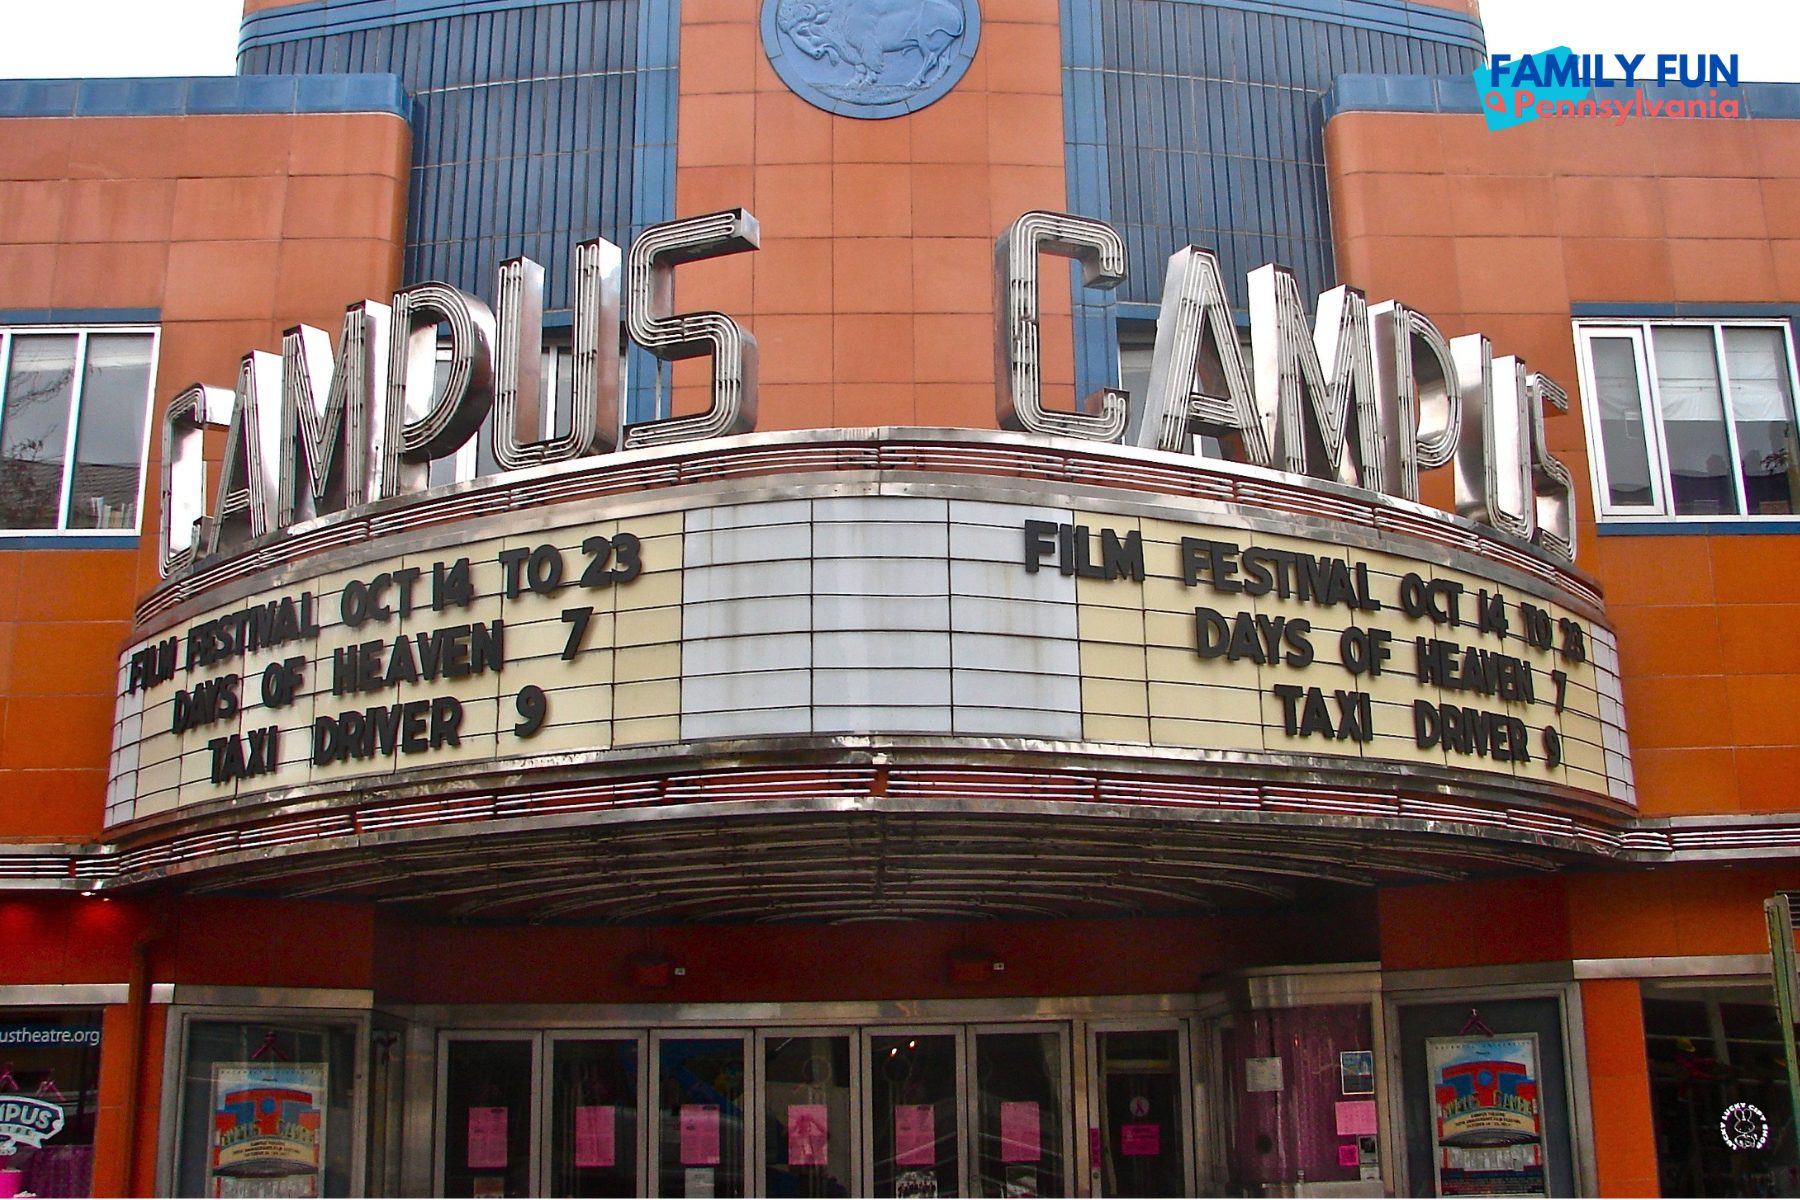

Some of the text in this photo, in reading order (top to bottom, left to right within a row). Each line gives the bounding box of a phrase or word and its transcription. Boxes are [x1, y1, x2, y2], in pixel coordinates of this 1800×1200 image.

[160, 207, 760, 580] CAMPUS
[996, 210, 1577, 564] CAMPUS
[128, 532, 643, 695] FILM FESTIVAL OCT 14 TO 23
[1025, 519, 1585, 663] FILM FESTIVAL OCT 14 TO 23
[172, 607, 594, 735] DAYS OF HEAVEN 7
[1195, 607, 1567, 713] DAYS OF HEAVEN 7
[1274, 683, 1561, 768] TAXI DRIVER 9
[208, 685, 547, 784] TAXI DRIVER 9
